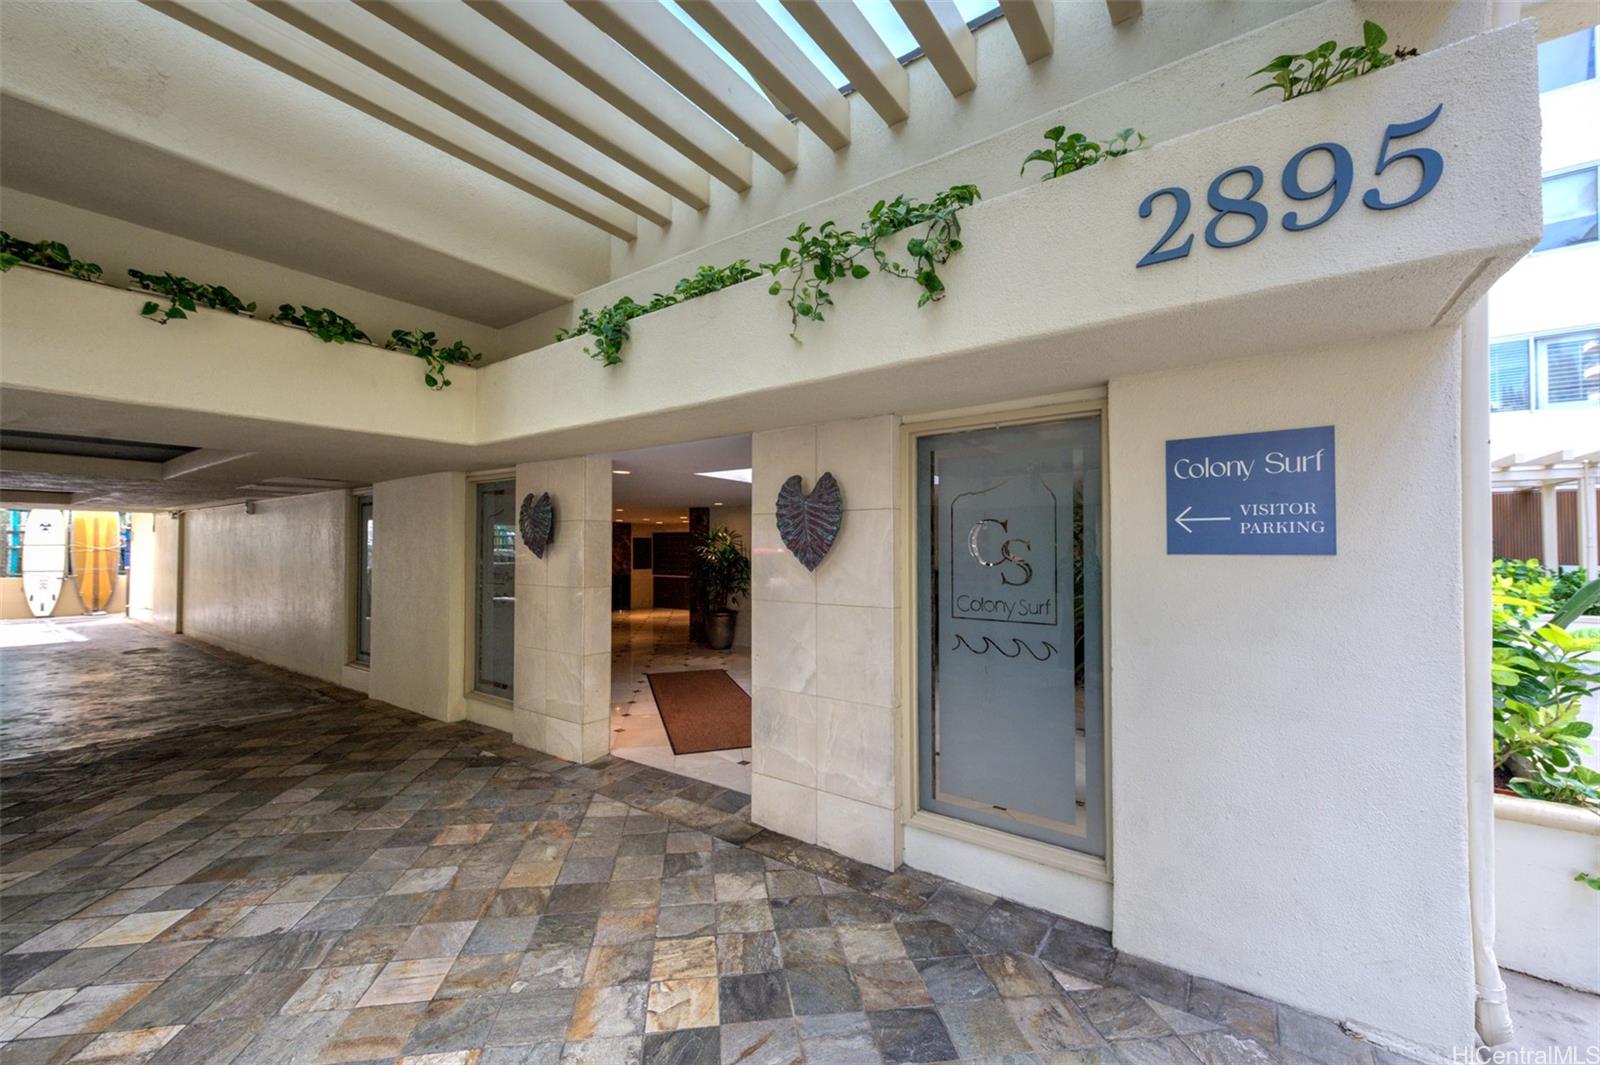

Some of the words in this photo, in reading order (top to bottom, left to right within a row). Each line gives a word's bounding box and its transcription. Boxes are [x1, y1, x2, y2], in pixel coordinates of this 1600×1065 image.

[1136, 103, 1444, 268] 2895
[1174, 457, 1255, 482] Colony
[1265, 448, 1325, 474] Surf
[1240, 502, 1317, 516] VISITOR
[1240, 521, 1325, 534] PARKING
[957, 594, 1016, 619] Colony
[1018, 599, 1052, 617] Surf
